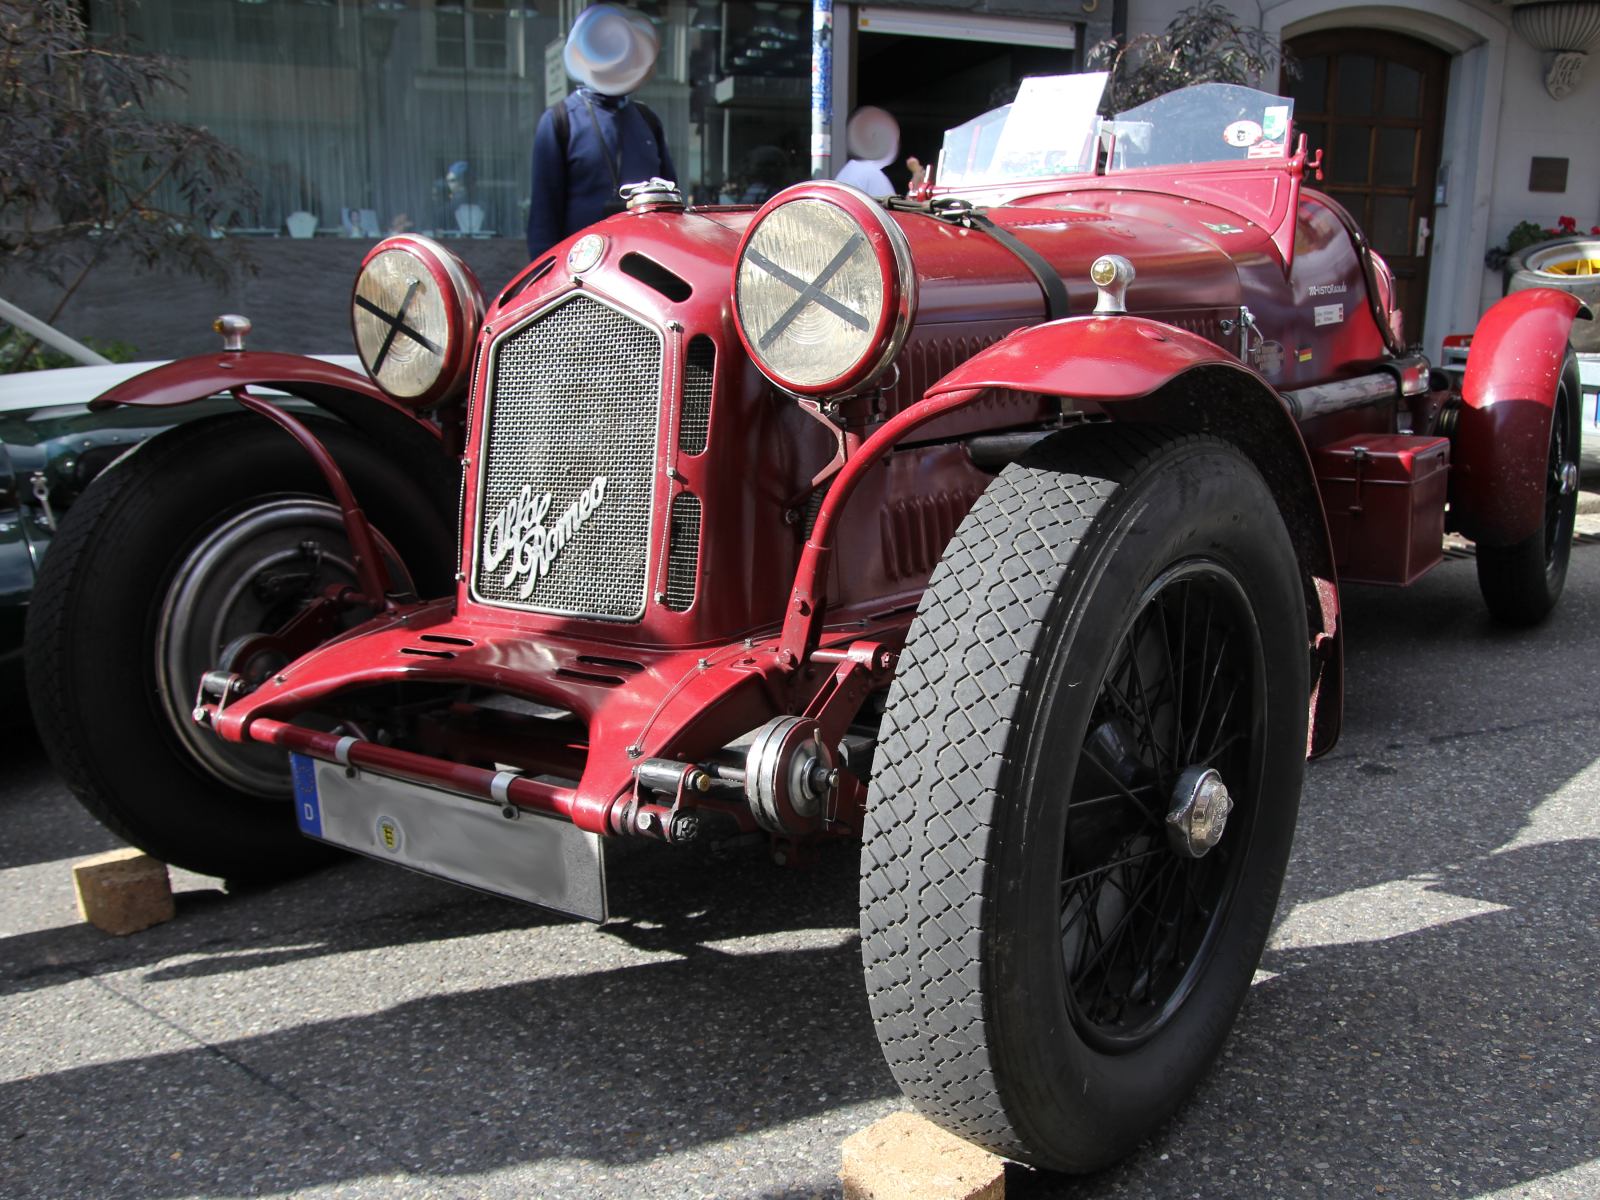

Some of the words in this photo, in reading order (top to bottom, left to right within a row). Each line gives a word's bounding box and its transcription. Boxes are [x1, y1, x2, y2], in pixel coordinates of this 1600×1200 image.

[483, 484, 552, 588] Alfa
[517, 476, 607, 599] Romeo
[304, 803, 314, 820] D
